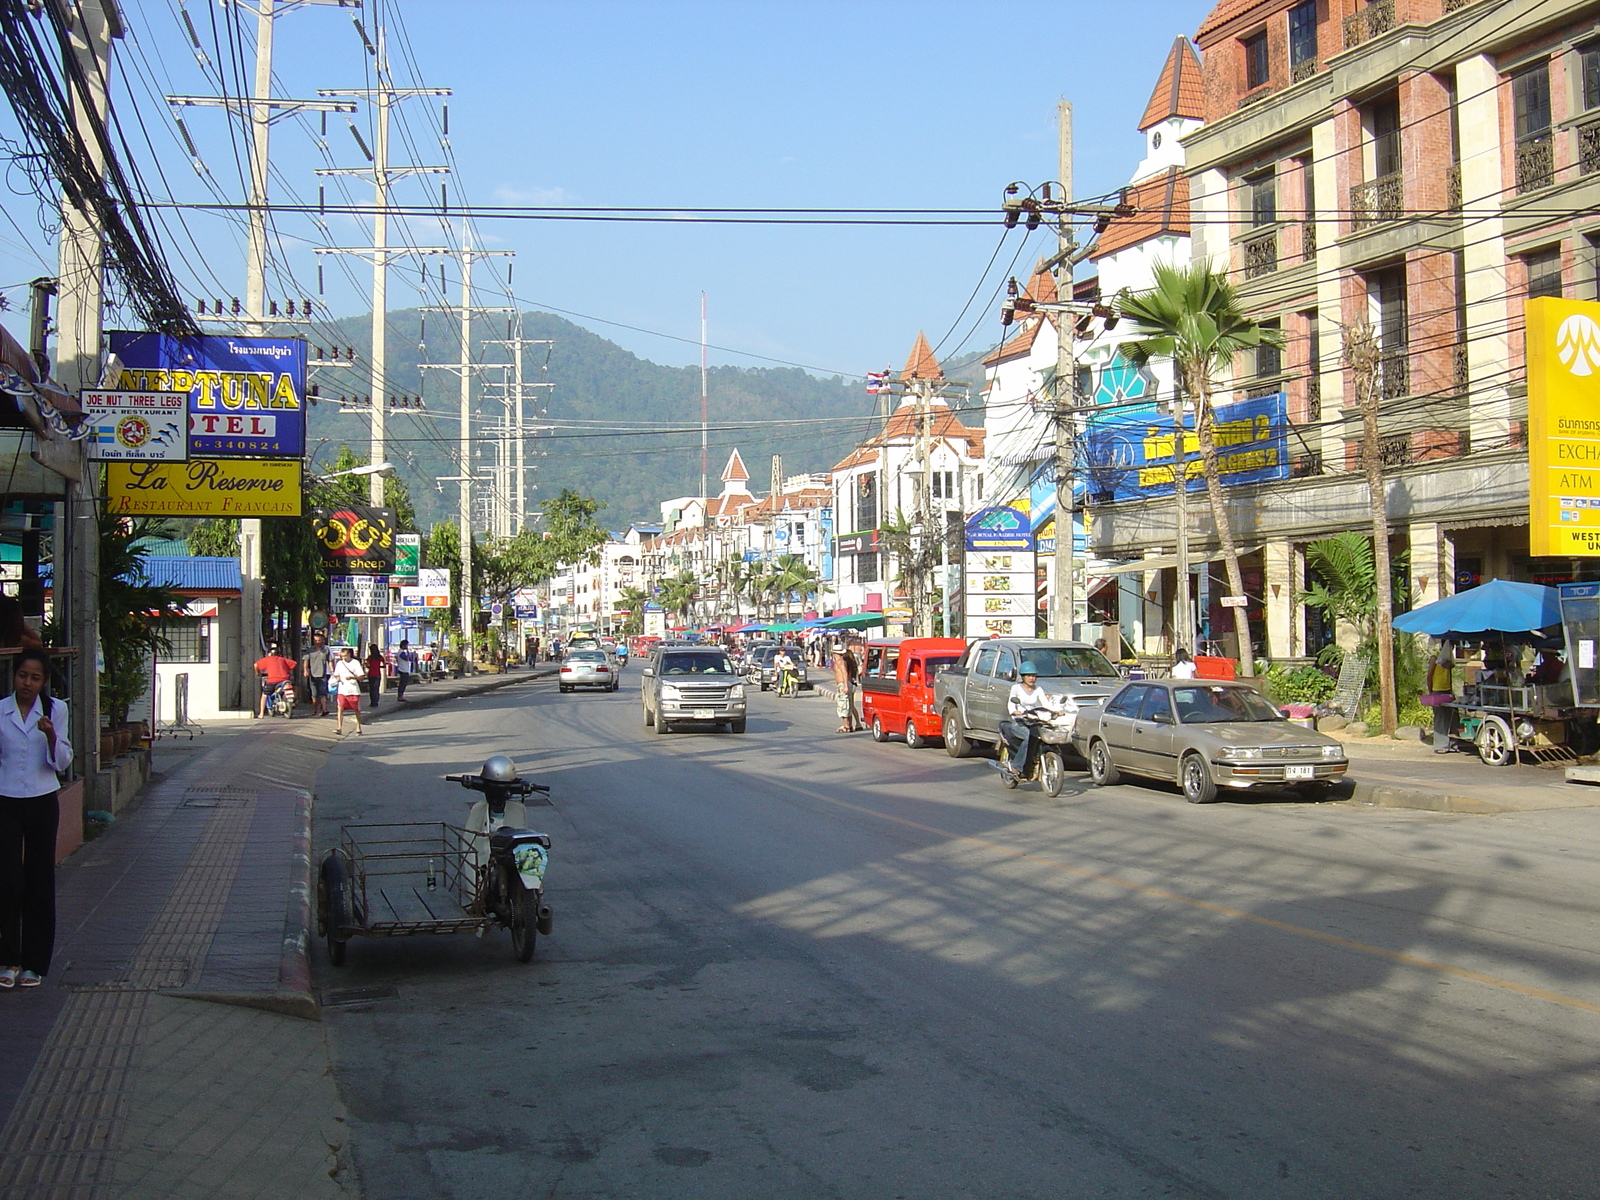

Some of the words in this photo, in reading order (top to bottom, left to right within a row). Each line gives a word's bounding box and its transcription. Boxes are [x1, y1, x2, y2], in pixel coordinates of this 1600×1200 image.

[86, 394, 103, 406] JOE
[106, 395, 122, 406] NUT
[129, 396, 155, 407] THREE
[160, 396, 182, 407] LEGS
[125, 462, 169, 490] La
[1560, 473, 1592, 489] ATM
[350, 559, 386, 570] sheep
[331, 582, 355, 590] TAKING
[1570, 586, 1593, 596] TOT
[354, 590, 365, 598] FOR
